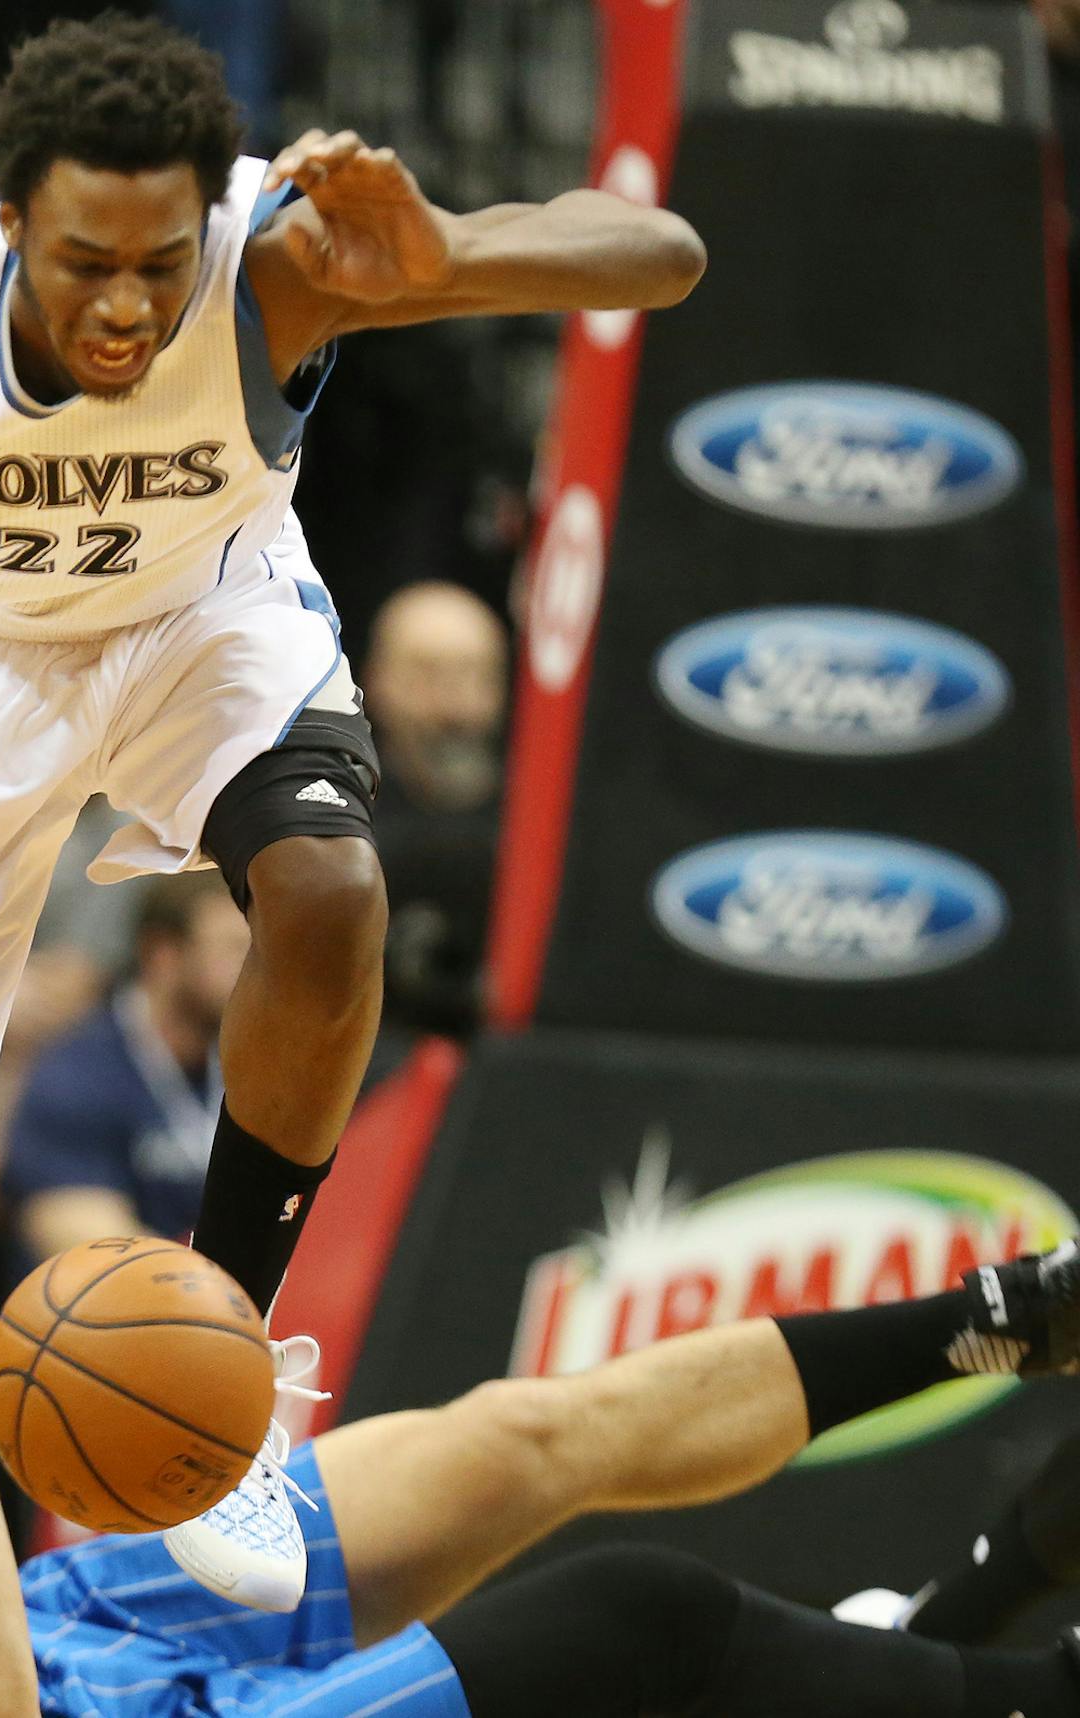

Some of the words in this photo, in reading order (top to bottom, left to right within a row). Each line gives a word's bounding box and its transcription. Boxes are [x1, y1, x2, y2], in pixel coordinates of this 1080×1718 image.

[734, 398, 953, 508] Ford
[720, 622, 938, 737] Ford
[716, 847, 933, 961] Ford
